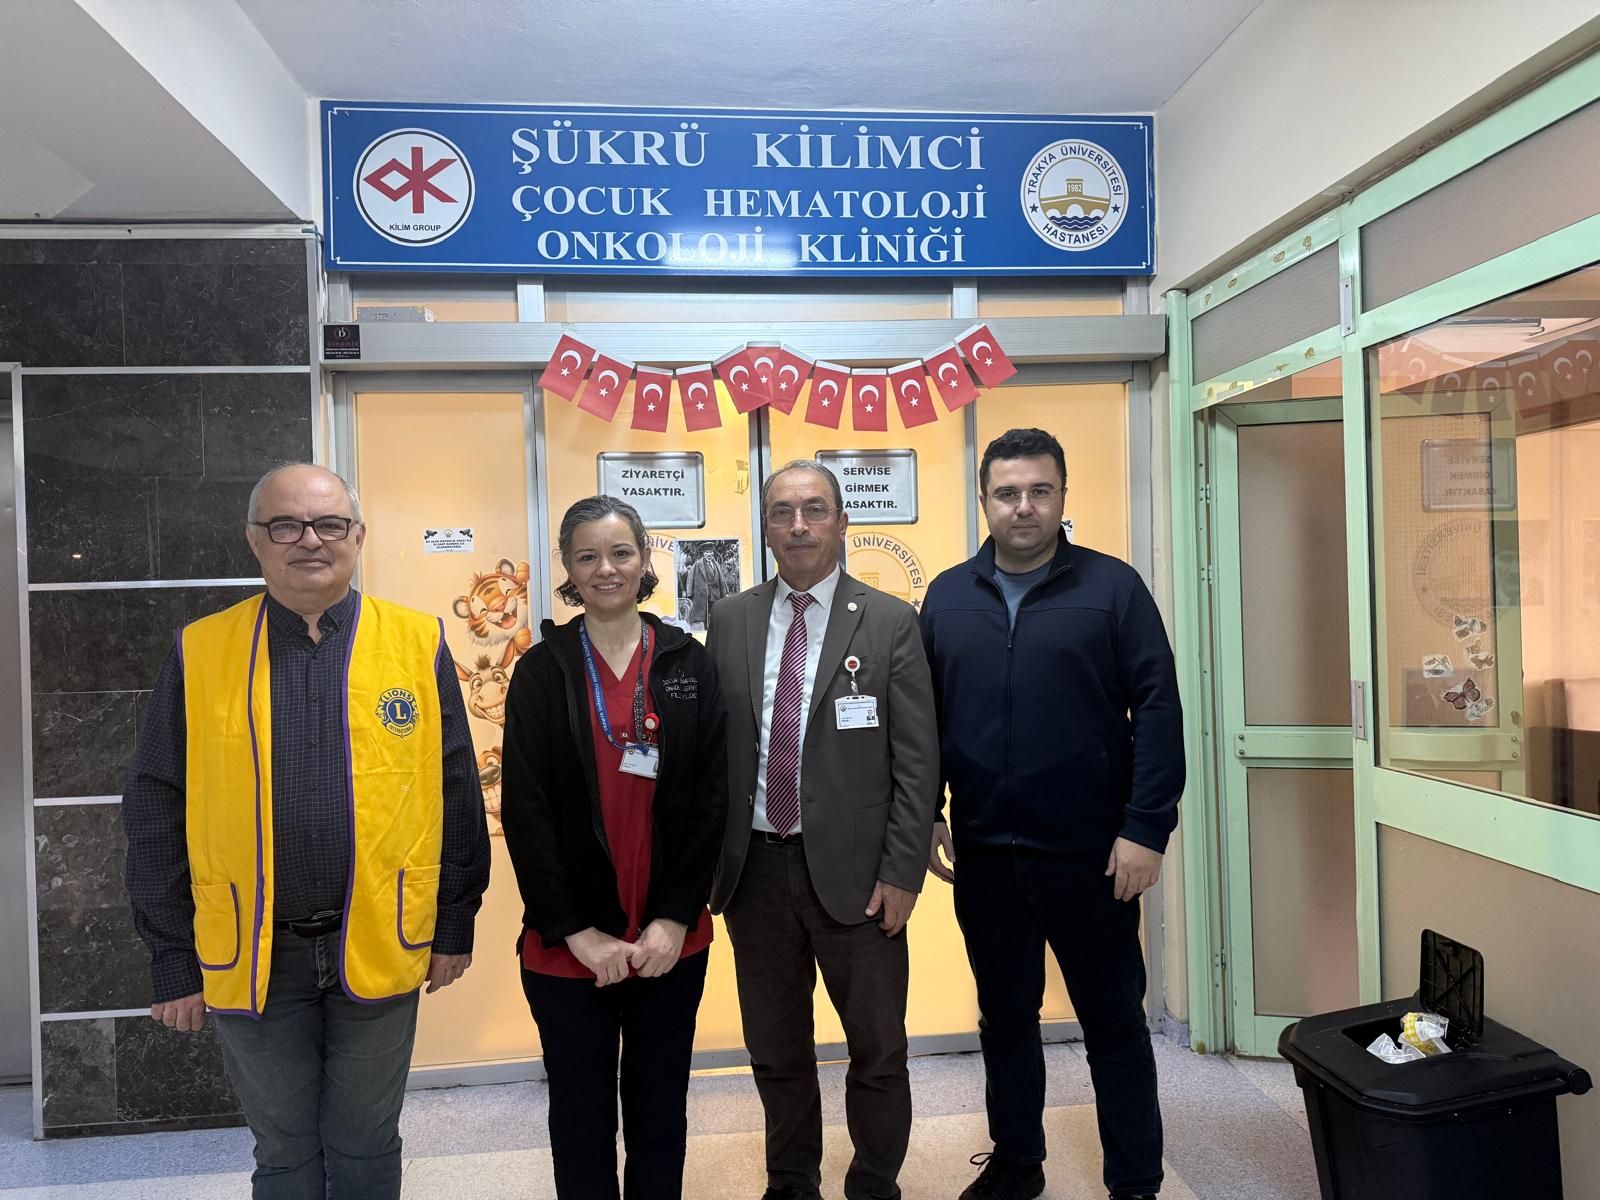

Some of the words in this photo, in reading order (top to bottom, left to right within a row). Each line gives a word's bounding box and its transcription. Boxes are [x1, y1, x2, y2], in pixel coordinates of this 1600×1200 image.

[511, 119, 710, 174] ŞÜKRÜ
[752, 124, 986, 171] KİLİMCİ
[1028, 153, 1057, 195] TRAKYA
[1060, 145, 1124, 196] ÜNİVERSİTESİ
[1067, 184, 1083, 193] 1982
[511, 184, 672, 221] ÇOCUK
[703, 184, 988, 219] HEMATOLOJİ
[389, 223, 411, 231] KİLİM
[1042, 223, 1109, 244] HASTANESİ
[537, 226, 766, 262] ONKOLOJİ
[798, 226, 967, 264] KLİNİĞİ
[621, 468, 685, 481] ZİYARETÇİ
[843, 466, 891, 476] SERVİSE
[621, 487, 685, 497] YASAKTIR.
[845, 483, 889, 493] GİRMEK
[842, 500, 898, 509] ASAKTIR.
[853, 535, 925, 589] ÜNİVERSİTESİ
[382, 690, 412, 700] LIONS
[394, 703, 407, 720] L
